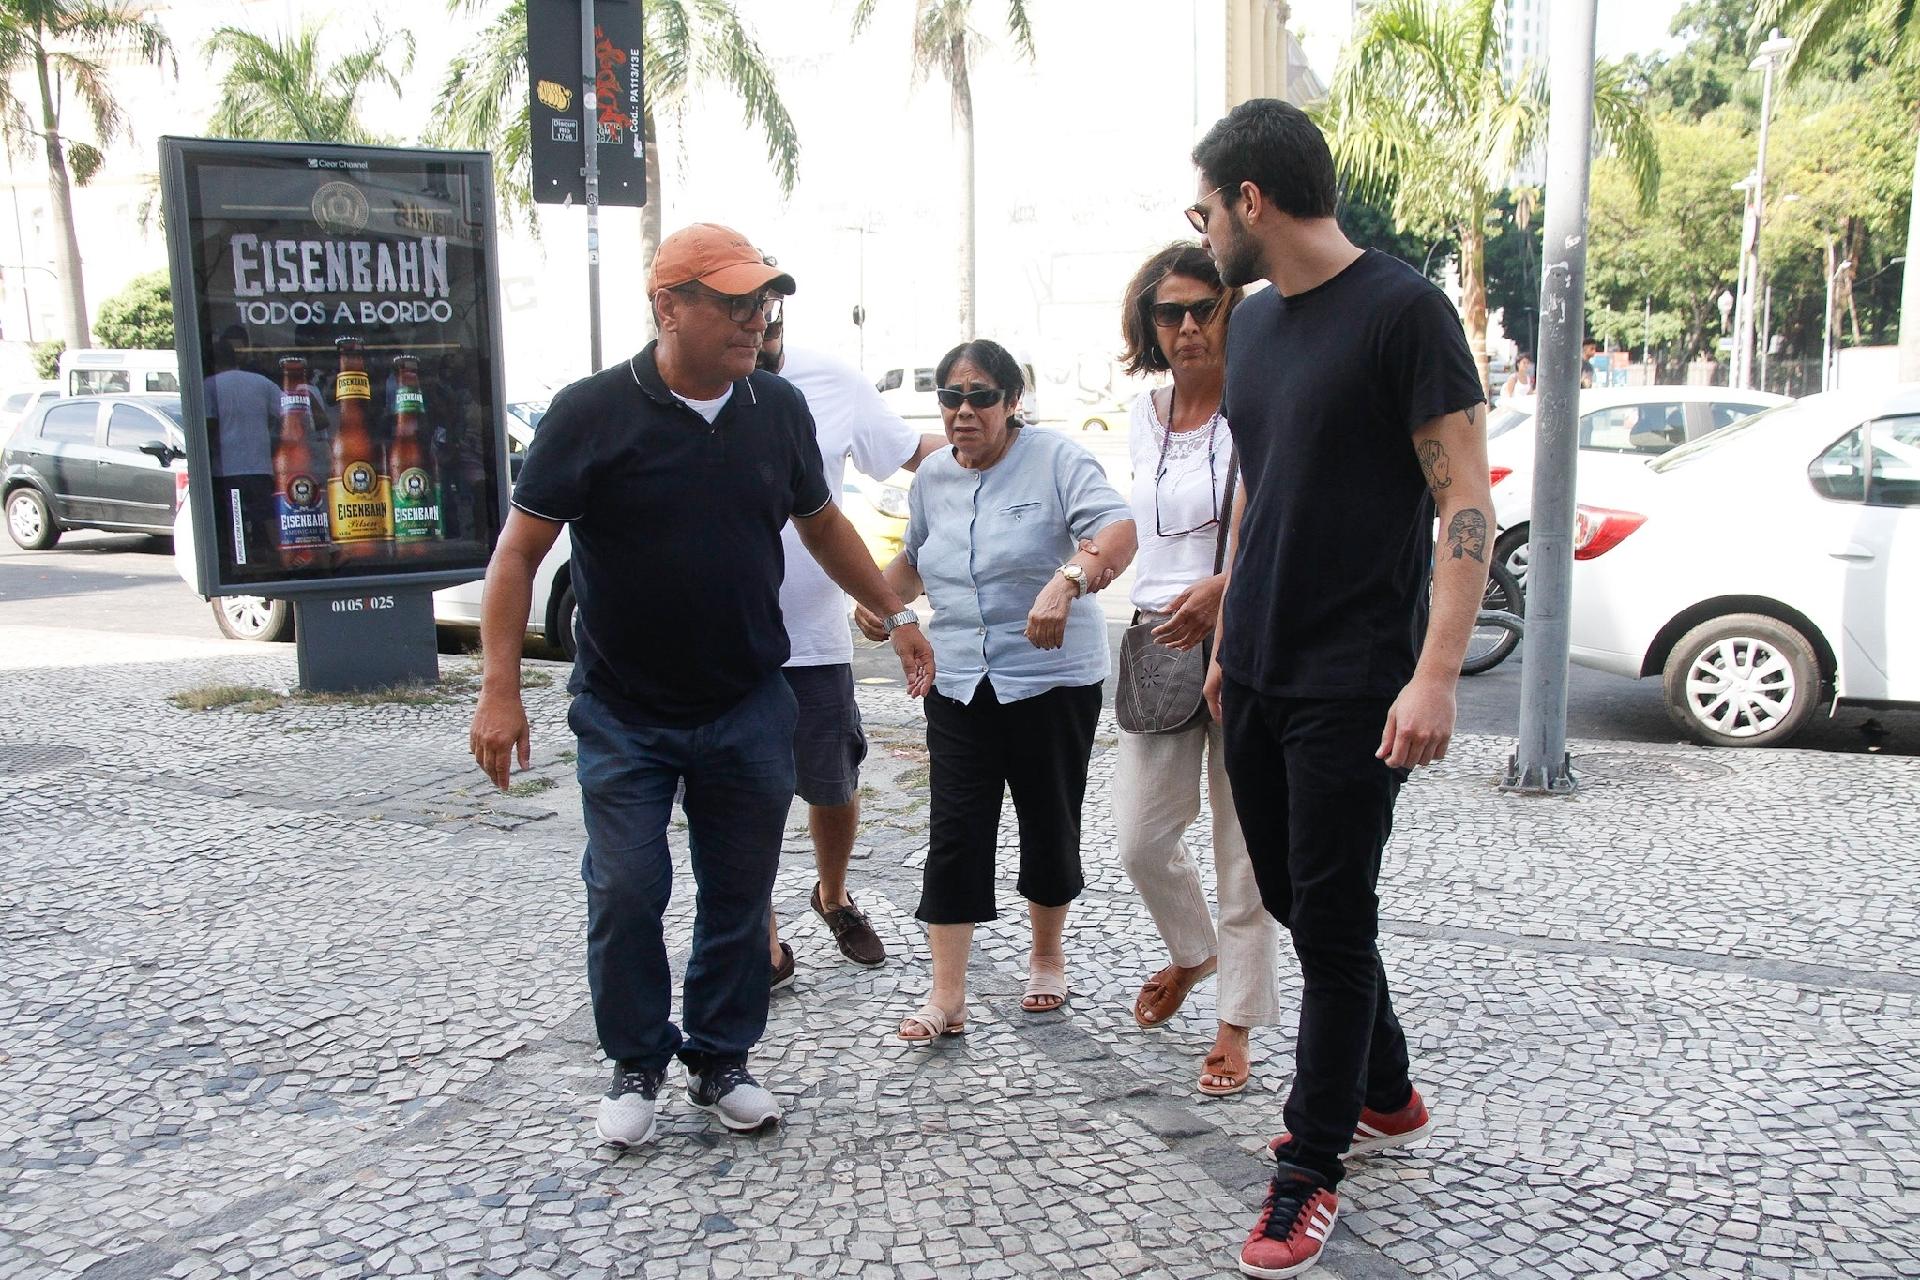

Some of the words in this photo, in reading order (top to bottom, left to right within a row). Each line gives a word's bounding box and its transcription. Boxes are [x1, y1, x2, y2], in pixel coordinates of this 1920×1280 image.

[630, 48, 640, 102] PA113/13E
[319, 159, 338, 168] Clear
[339, 160, 369, 169] Channel
[230, 233, 450, 298] EISENBAHN
[236, 301, 327, 325] TODOS
[332, 301, 356, 324] A
[360, 300, 453, 324] BORDO
[337, 502, 387, 520] EISENBAHN
[394, 505, 439, 523] EISENBAHN
[280, 512, 329, 530] EISENBAHN
[331, 598, 364, 612] 0105
[370, 595, 395, 609] 025
